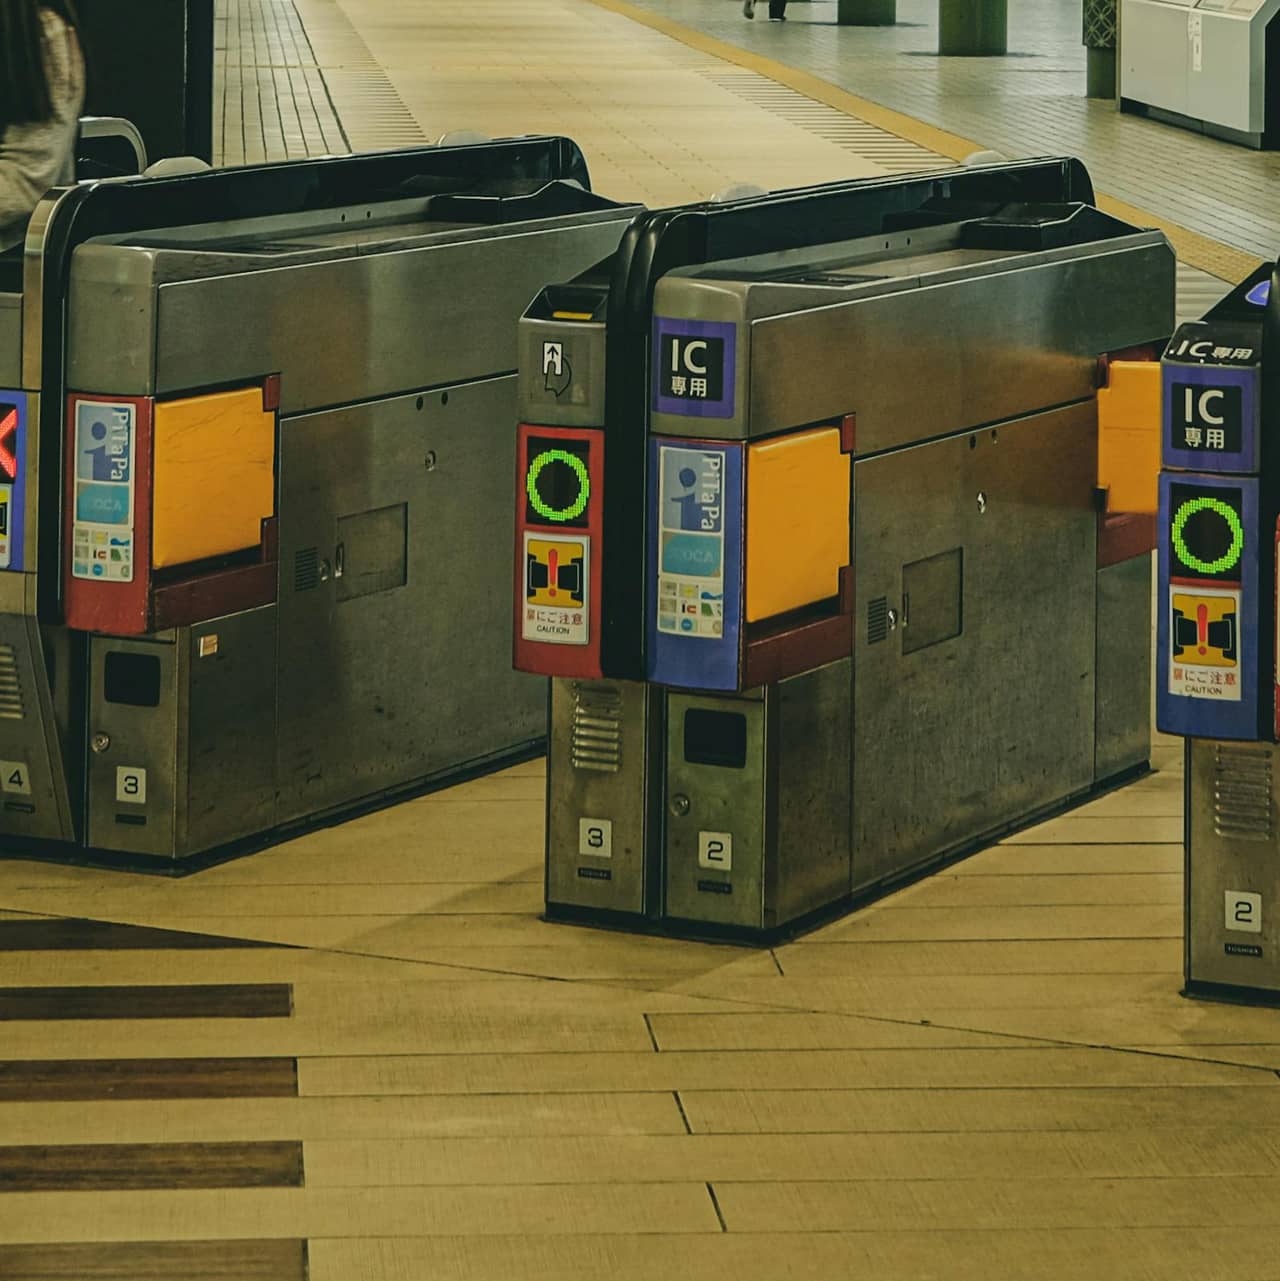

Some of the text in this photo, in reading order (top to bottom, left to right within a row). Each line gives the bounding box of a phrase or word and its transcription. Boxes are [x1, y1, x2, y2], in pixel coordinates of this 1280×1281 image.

[672, 339, 707, 374] IC
[1178, 340, 1252, 361] IC専用
[671, 377, 707, 398] 専用
[1185, 389, 1224, 424] IC
[111, 412, 128, 480] PiTaPa
[1184, 428, 1225, 449] 専用
[701, 457, 720, 529] PiTaPa
[537, 624, 570, 635] CAUTION
[1184, 685, 1222, 695] CAUTION
[8, 770, 23, 786] 4
[124, 776, 138, 794] 3
[588, 828, 603, 848] 3
[707, 841, 723, 861] 2
[1235, 901, 1252, 922] 2
